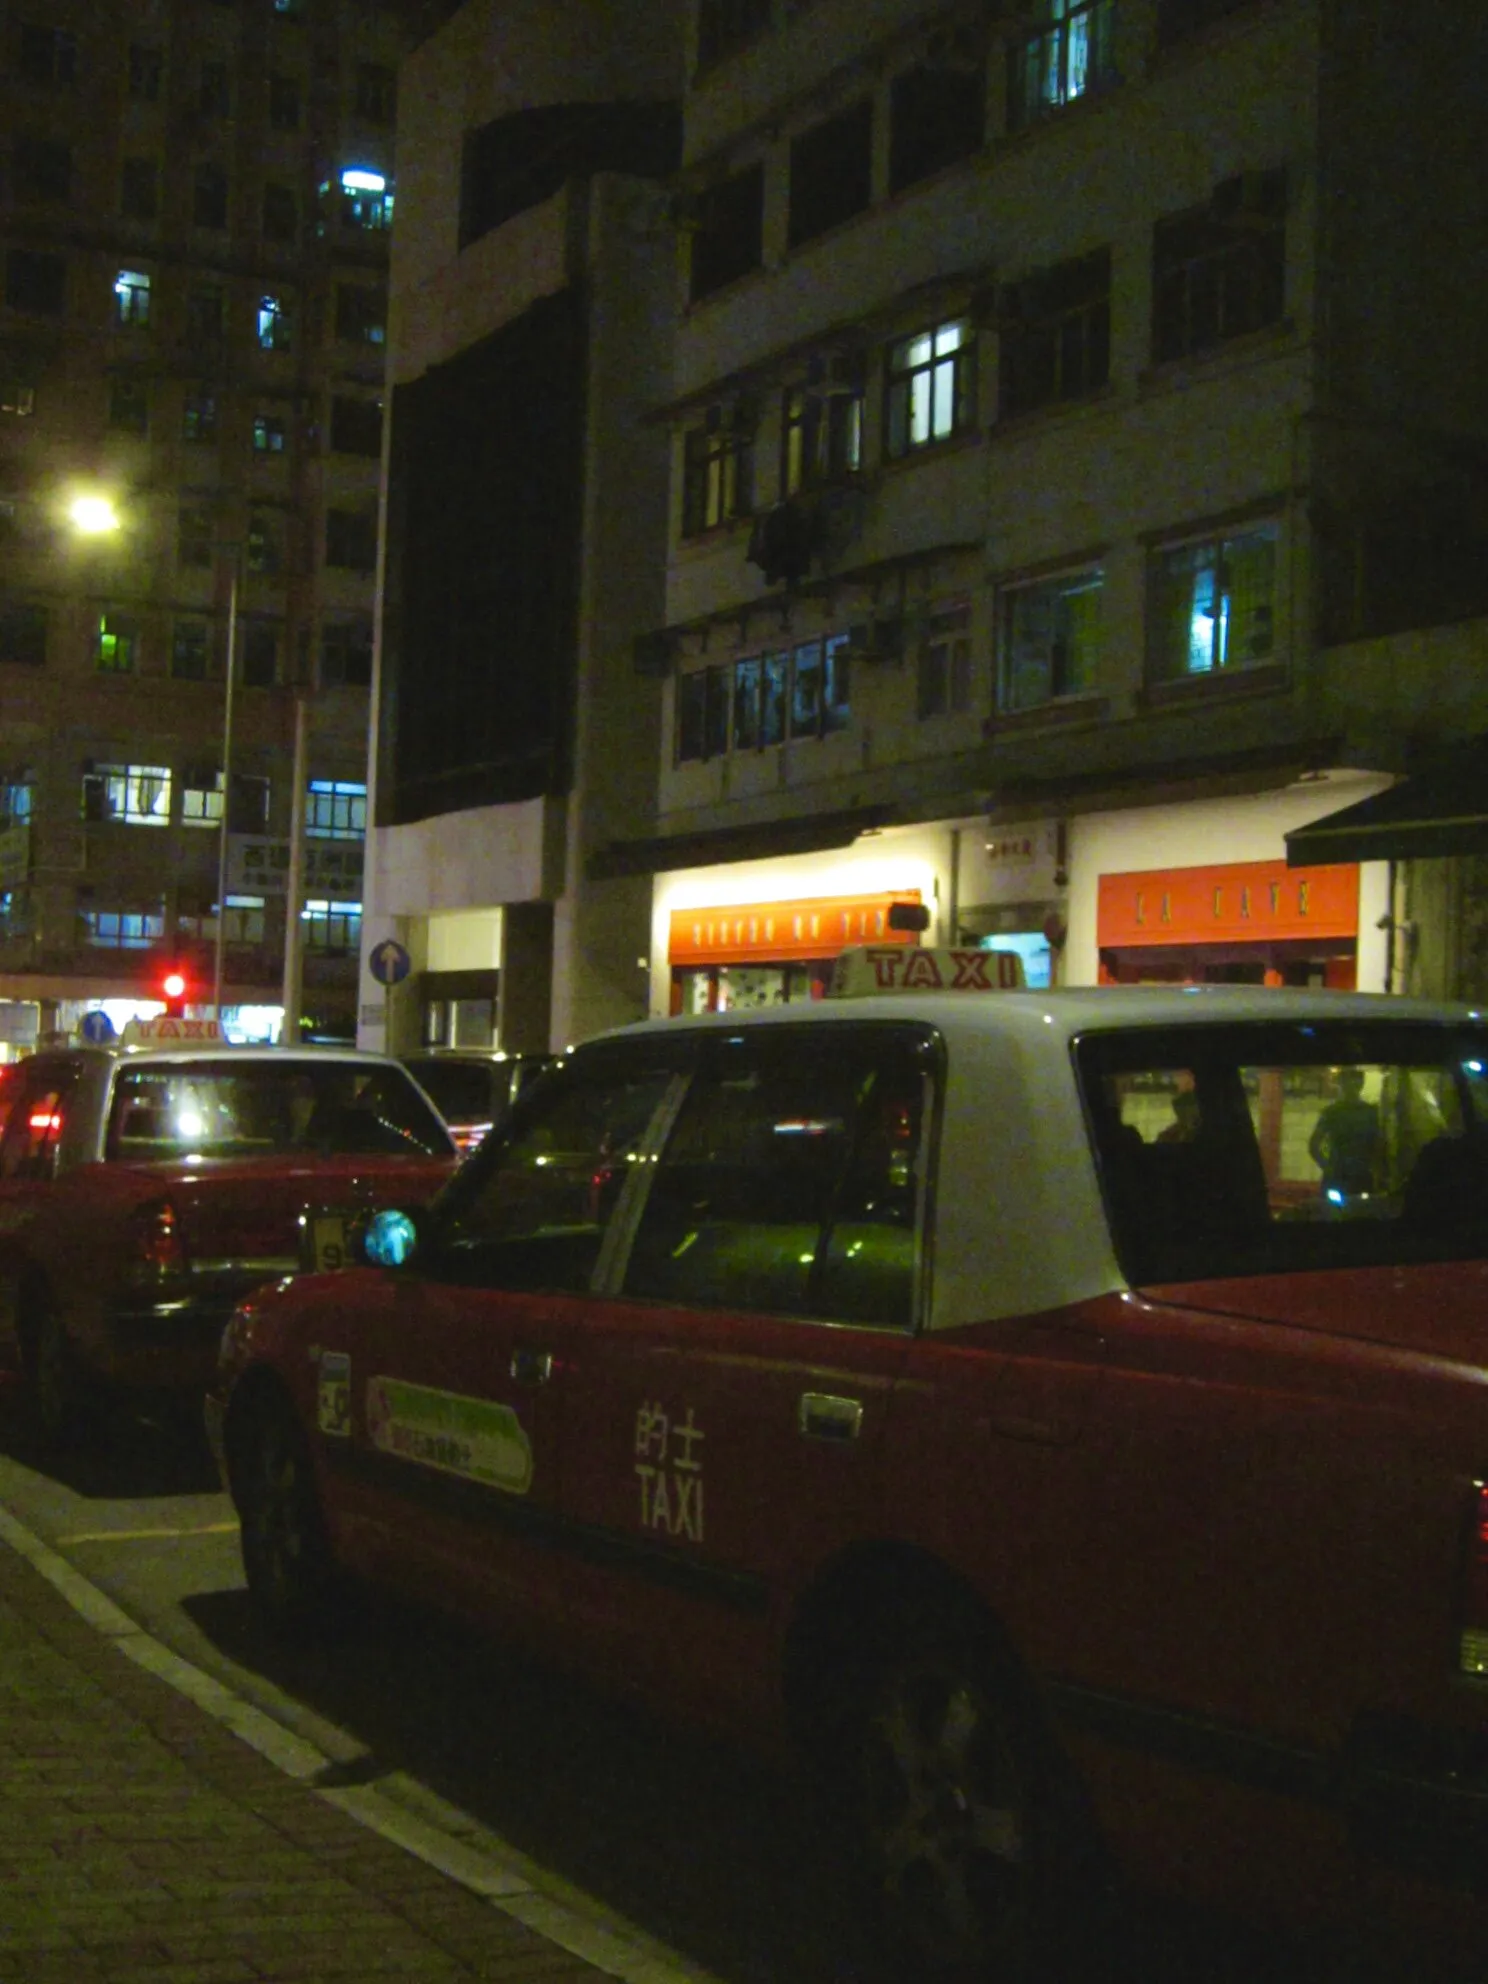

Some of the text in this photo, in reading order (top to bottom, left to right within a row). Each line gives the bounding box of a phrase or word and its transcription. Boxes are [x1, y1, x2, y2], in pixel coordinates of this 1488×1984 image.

[867, 949, 1018, 990] TAXI
[139, 1020, 218, 1039] TAXI
[635, 1399, 706, 1472] 的士
[634, 1463, 704, 1543] TAXI
